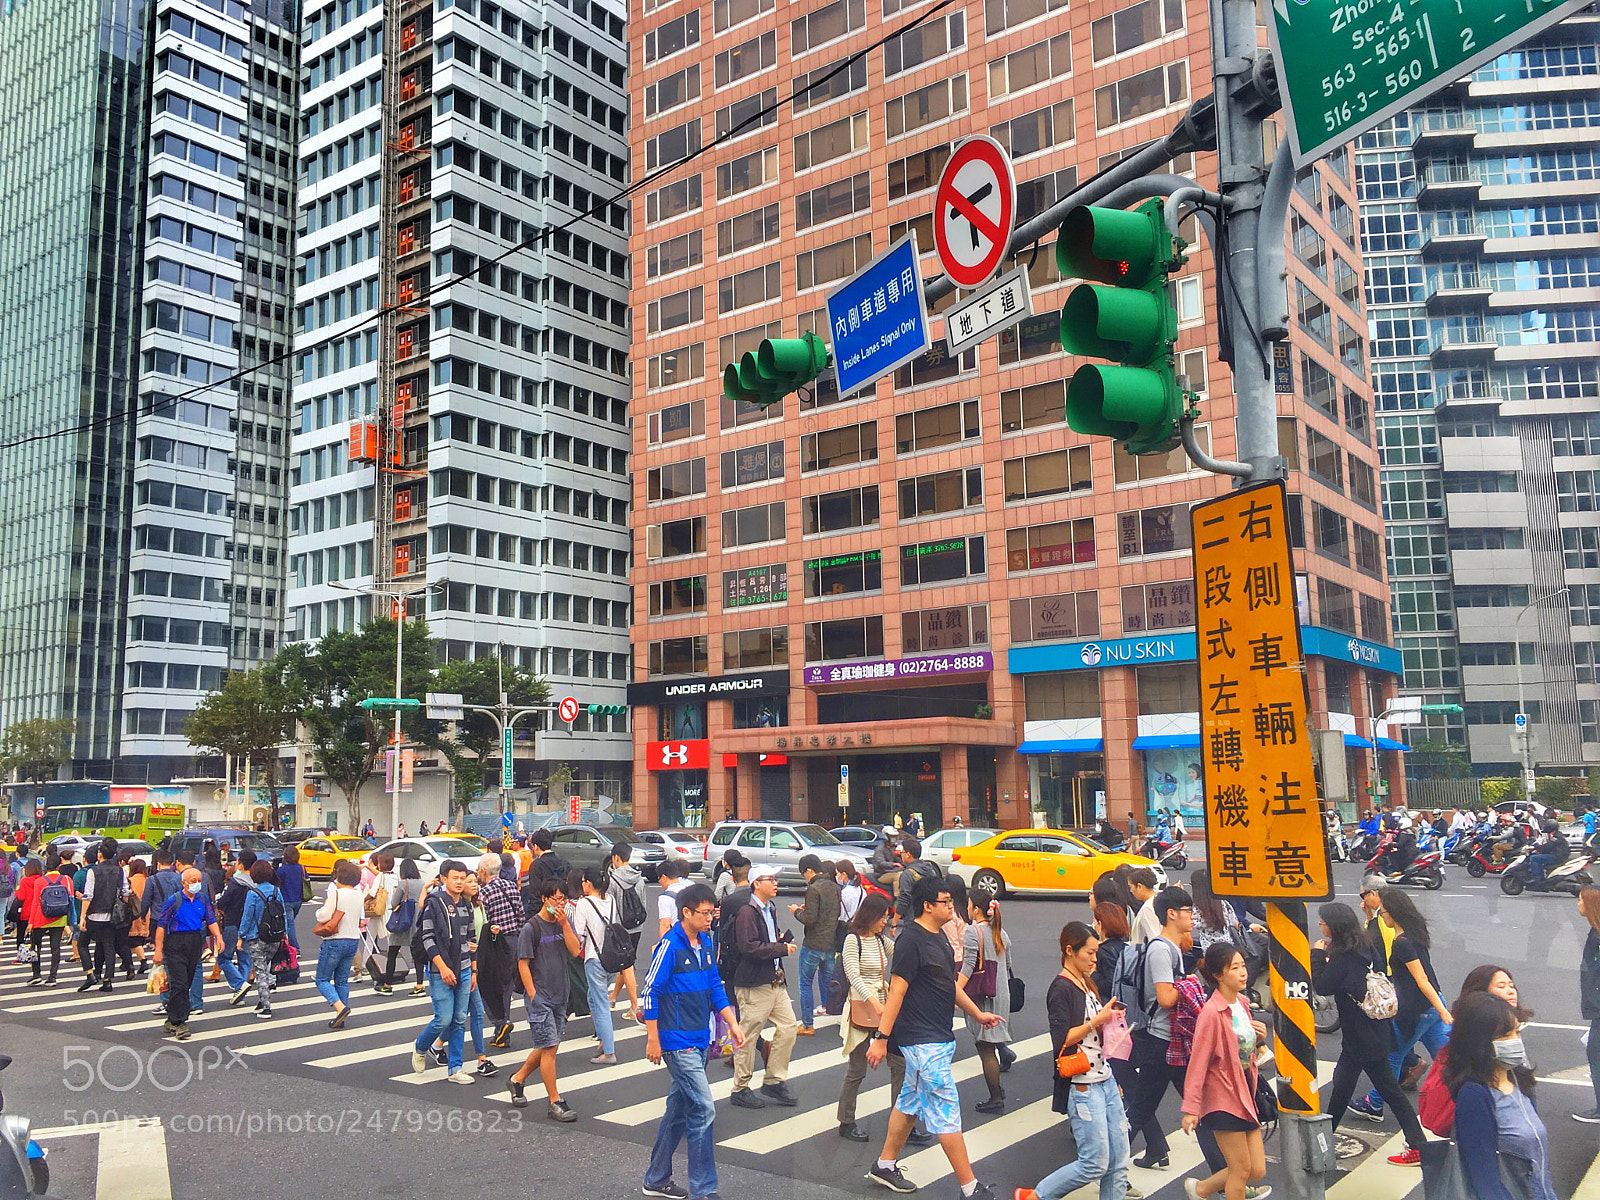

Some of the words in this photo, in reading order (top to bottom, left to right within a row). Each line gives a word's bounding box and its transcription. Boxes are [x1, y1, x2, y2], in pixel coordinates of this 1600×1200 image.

[1459, 27, 1477, 52] 2
[1321, 63, 1356, 97] 563
[1385, 59, 1422, 95] 560
[836, 266, 914, 342] 內側車道專用
[959, 287, 1016, 336] 地下道
[843, 353, 861, 371] Inside
[861, 342, 880, 360] Lanes
[880, 326, 901, 347] Signal
[901, 317, 917, 335] Only
[747, 591, 788, 604] 3765-678
[1106, 643, 1132, 662] NU
[1135, 640, 1175, 659] SKIN
[830, 662, 896, 682] 全真瑜珈健身
[899, 655, 984, 675] (02)2764-8888
[665, 682, 706, 696] UNDER
[708, 678, 763, 693] ARMOUR
[1201, 514, 1253, 887] 二段式左轉機車
[1238, 500, 1316, 889] 右側車輛注意
[1284, 981, 1309, 997] HC
